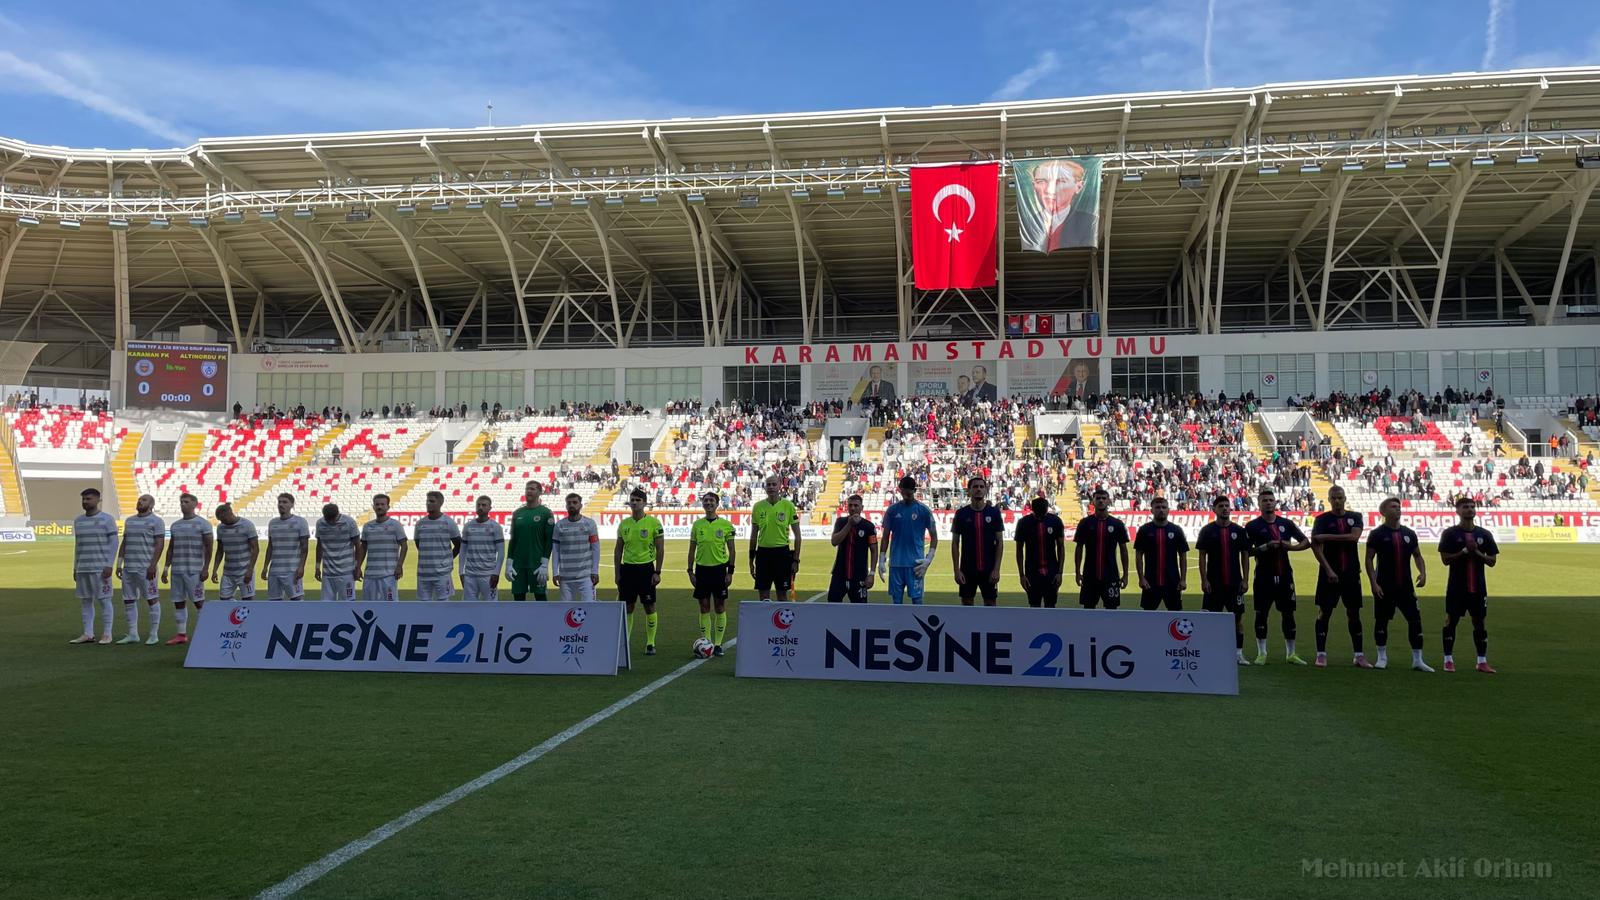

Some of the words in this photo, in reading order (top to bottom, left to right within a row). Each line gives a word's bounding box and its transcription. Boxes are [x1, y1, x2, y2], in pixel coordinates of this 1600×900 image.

[745, 342, 927, 364] KARAMAN
[946, 336, 1166, 360] STADYUMU
[138, 381, 150, 395] 0
[202, 383, 214, 396] 0
[161, 393, 191, 402] 00:00
